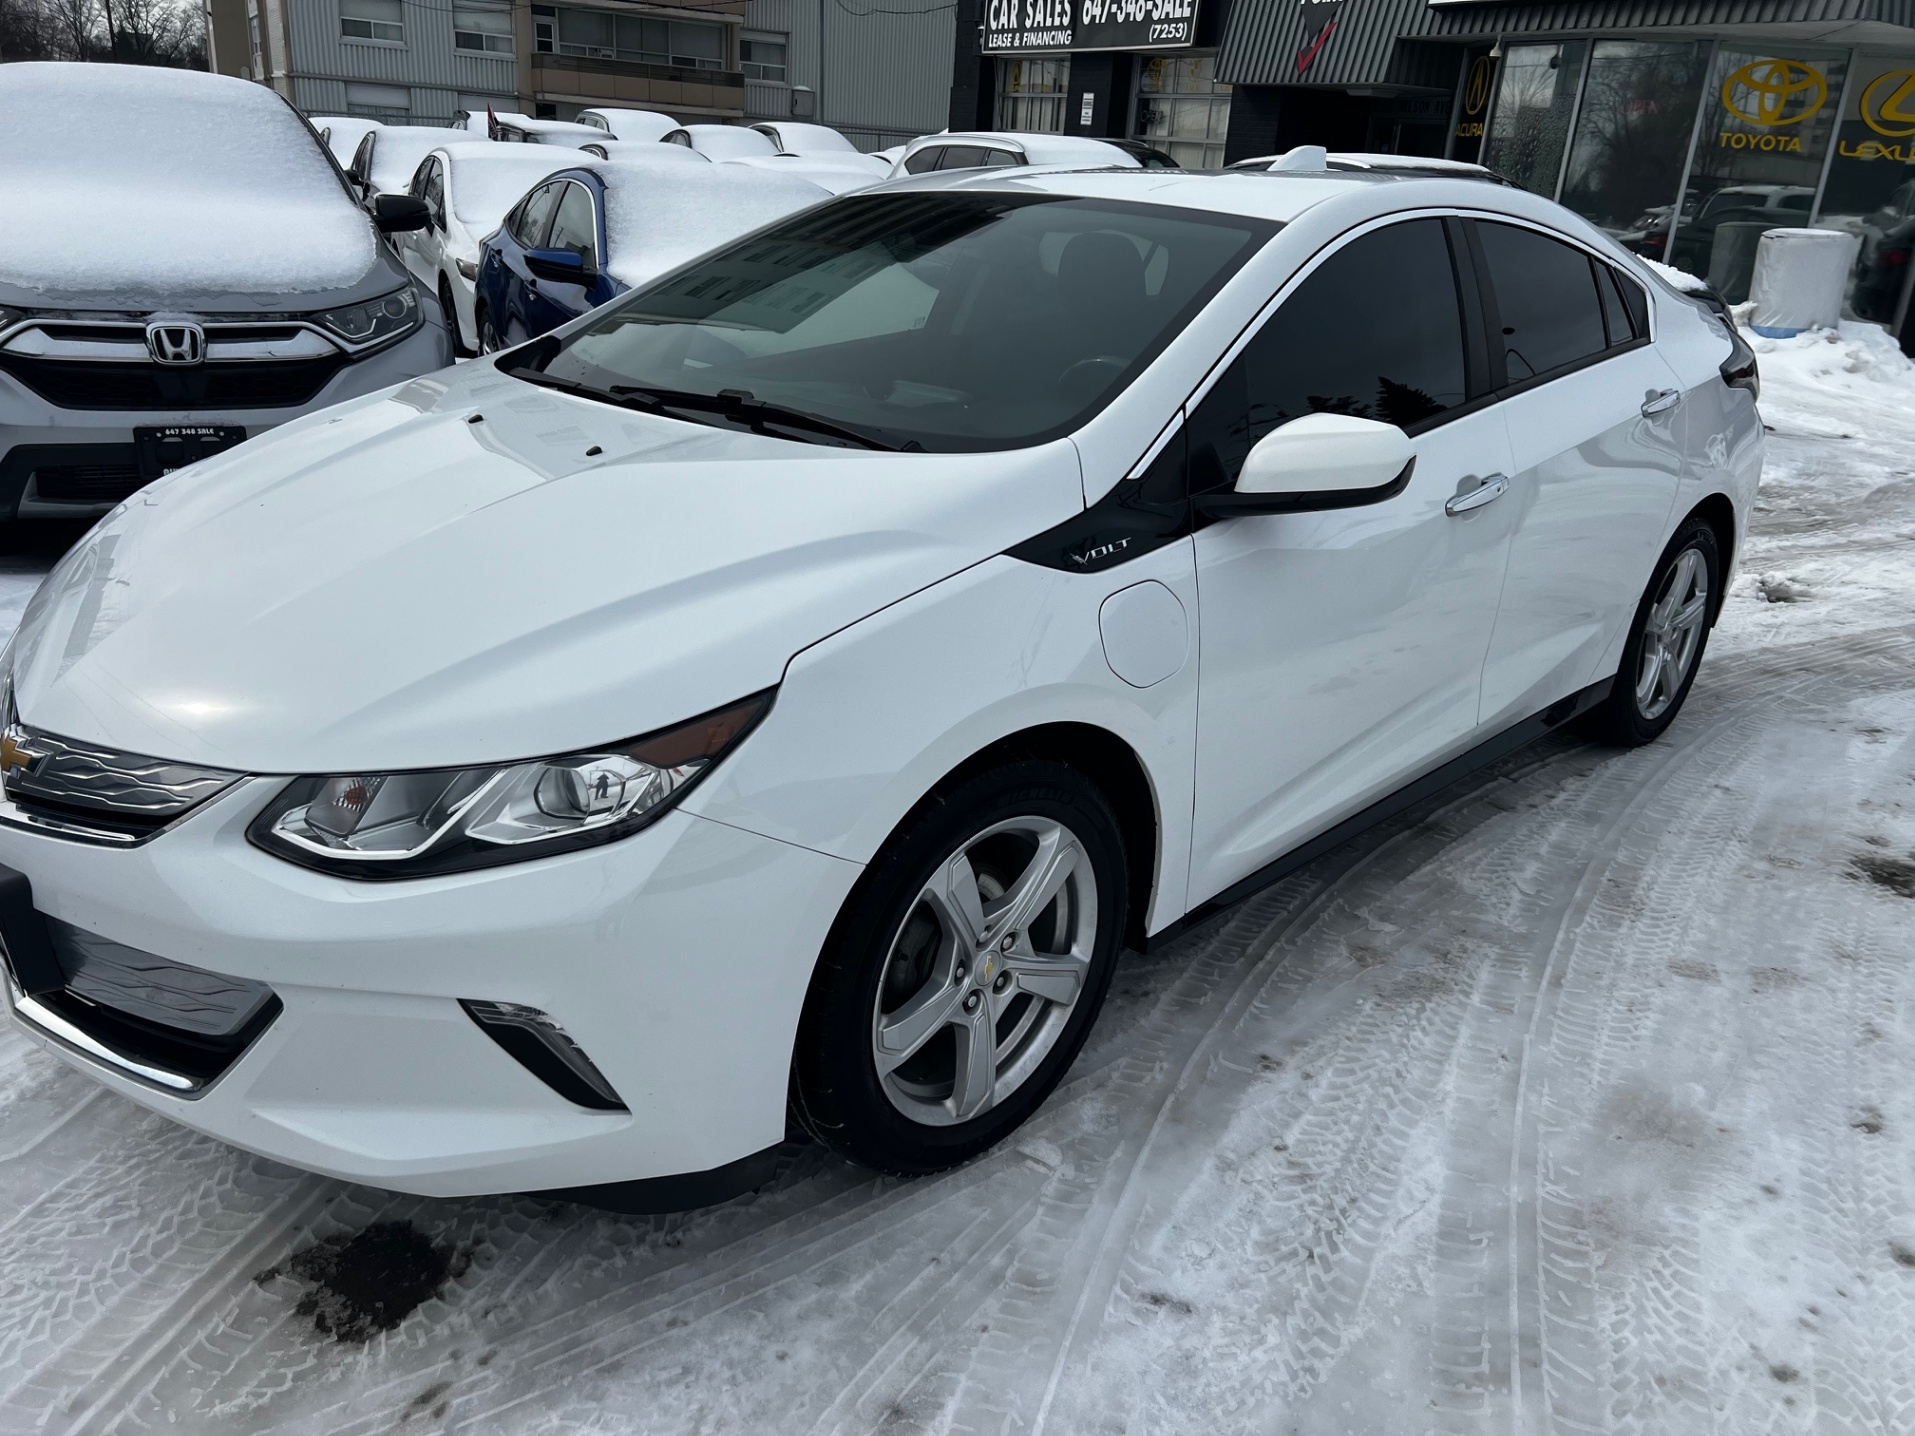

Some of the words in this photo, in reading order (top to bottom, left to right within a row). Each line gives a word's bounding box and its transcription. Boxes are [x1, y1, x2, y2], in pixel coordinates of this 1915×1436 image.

[990, 0, 1019, 30] CAR
[1025, 0, 1071, 28] SALES
[989, 33, 1012, 48] LEASE
[1013, 33, 1020, 47] &
[1022, 30, 1072, 46] FINANCING
[1149, 22, 1187, 42] (7253)
[1455, 123, 1483, 137] ACURA
[1720, 132, 1801, 152] TOYOTA
[1838, 140, 1915, 162] LEXU
[1069, 537, 1131, 565] VOLT
[997, 787, 1073, 807] MICHELIN
